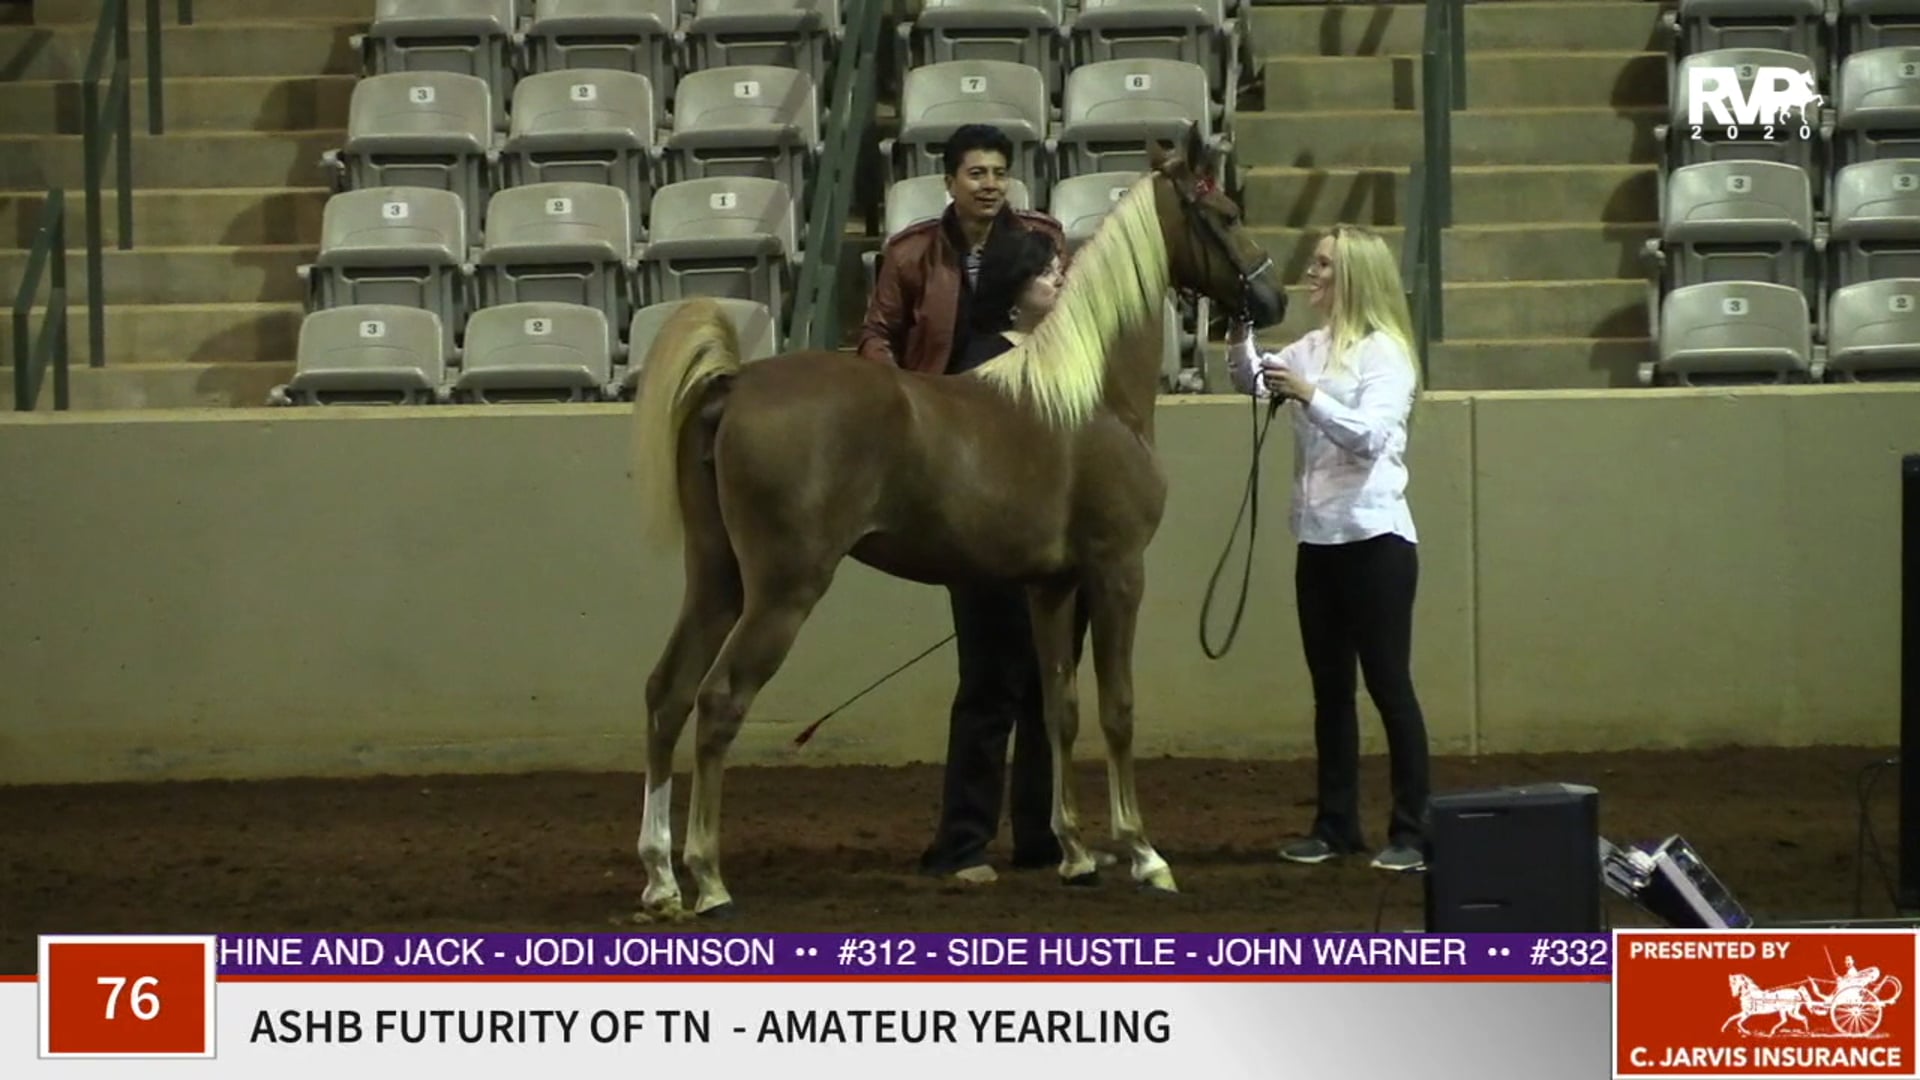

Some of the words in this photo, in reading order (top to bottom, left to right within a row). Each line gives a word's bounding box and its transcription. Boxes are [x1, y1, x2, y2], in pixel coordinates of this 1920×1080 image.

[1741, 66, 1752, 78] 3
[1904, 64, 1915, 76] 2
[969, 79, 980, 90] 7
[1133, 77, 1143, 87] 6
[417, 89, 428, 100] 3
[578, 87, 589, 97] 2
[743, 84, 750, 95] 1
[1734, 178, 1744, 190] 3
[1900, 176, 1911, 187] 2
[554, 201, 564, 211] 2
[719, 196, 727, 207] 1
[390, 205, 401, 216] 3
[1730, 300, 1741, 312] 3
[1896, 298, 1908, 309] 2
[367, 323, 378, 334] 3
[533, 321, 543, 332] 2
